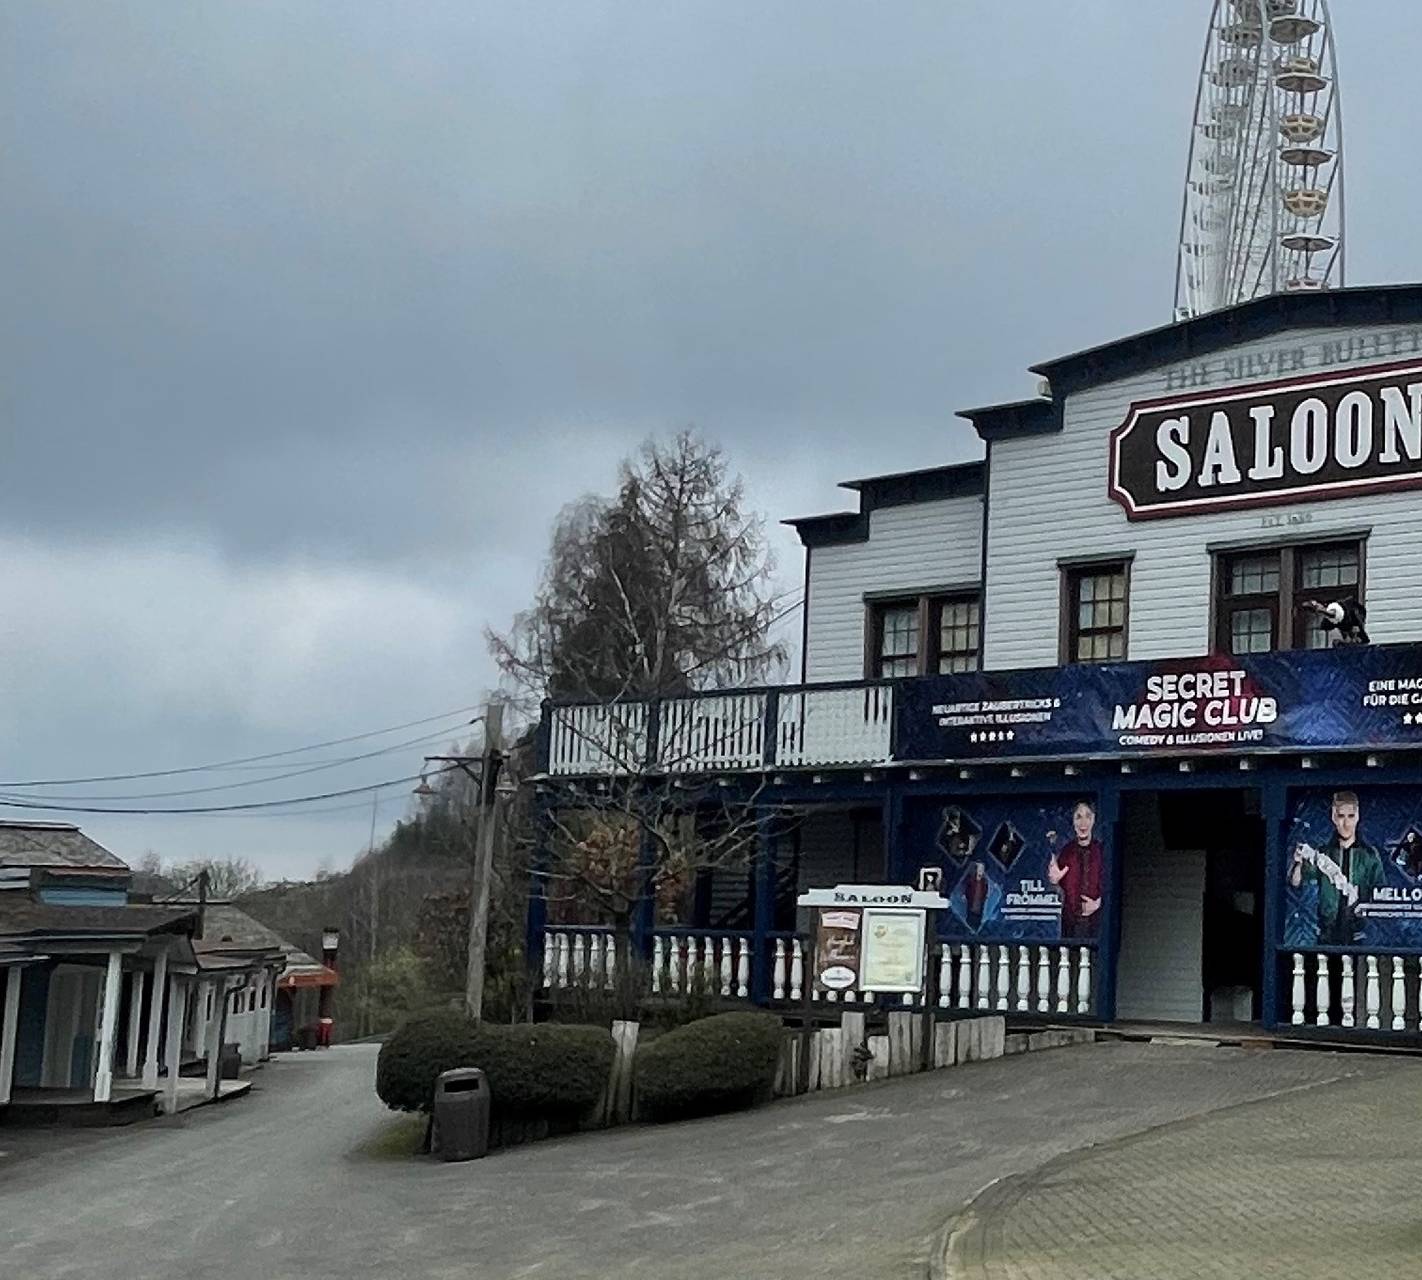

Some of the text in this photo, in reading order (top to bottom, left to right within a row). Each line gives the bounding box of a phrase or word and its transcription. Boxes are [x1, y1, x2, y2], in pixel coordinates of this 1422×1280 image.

[1147, 670, 1246, 702] SECRET
[1368, 679, 1396, 693] EINE
[1363, 693, 1387, 707] FÜR
[1388, 693, 1410, 706] DIE
[1111, 697, 1277, 730] MAGIC CLUB
[1119, 733, 1164, 746] COMEDY
[1165, 733, 1175, 745] &
[1175, 731, 1236, 744] ILLUSIONEN
[1020, 879, 1046, 892] TILL
[833, 892, 914, 903] SALOON
